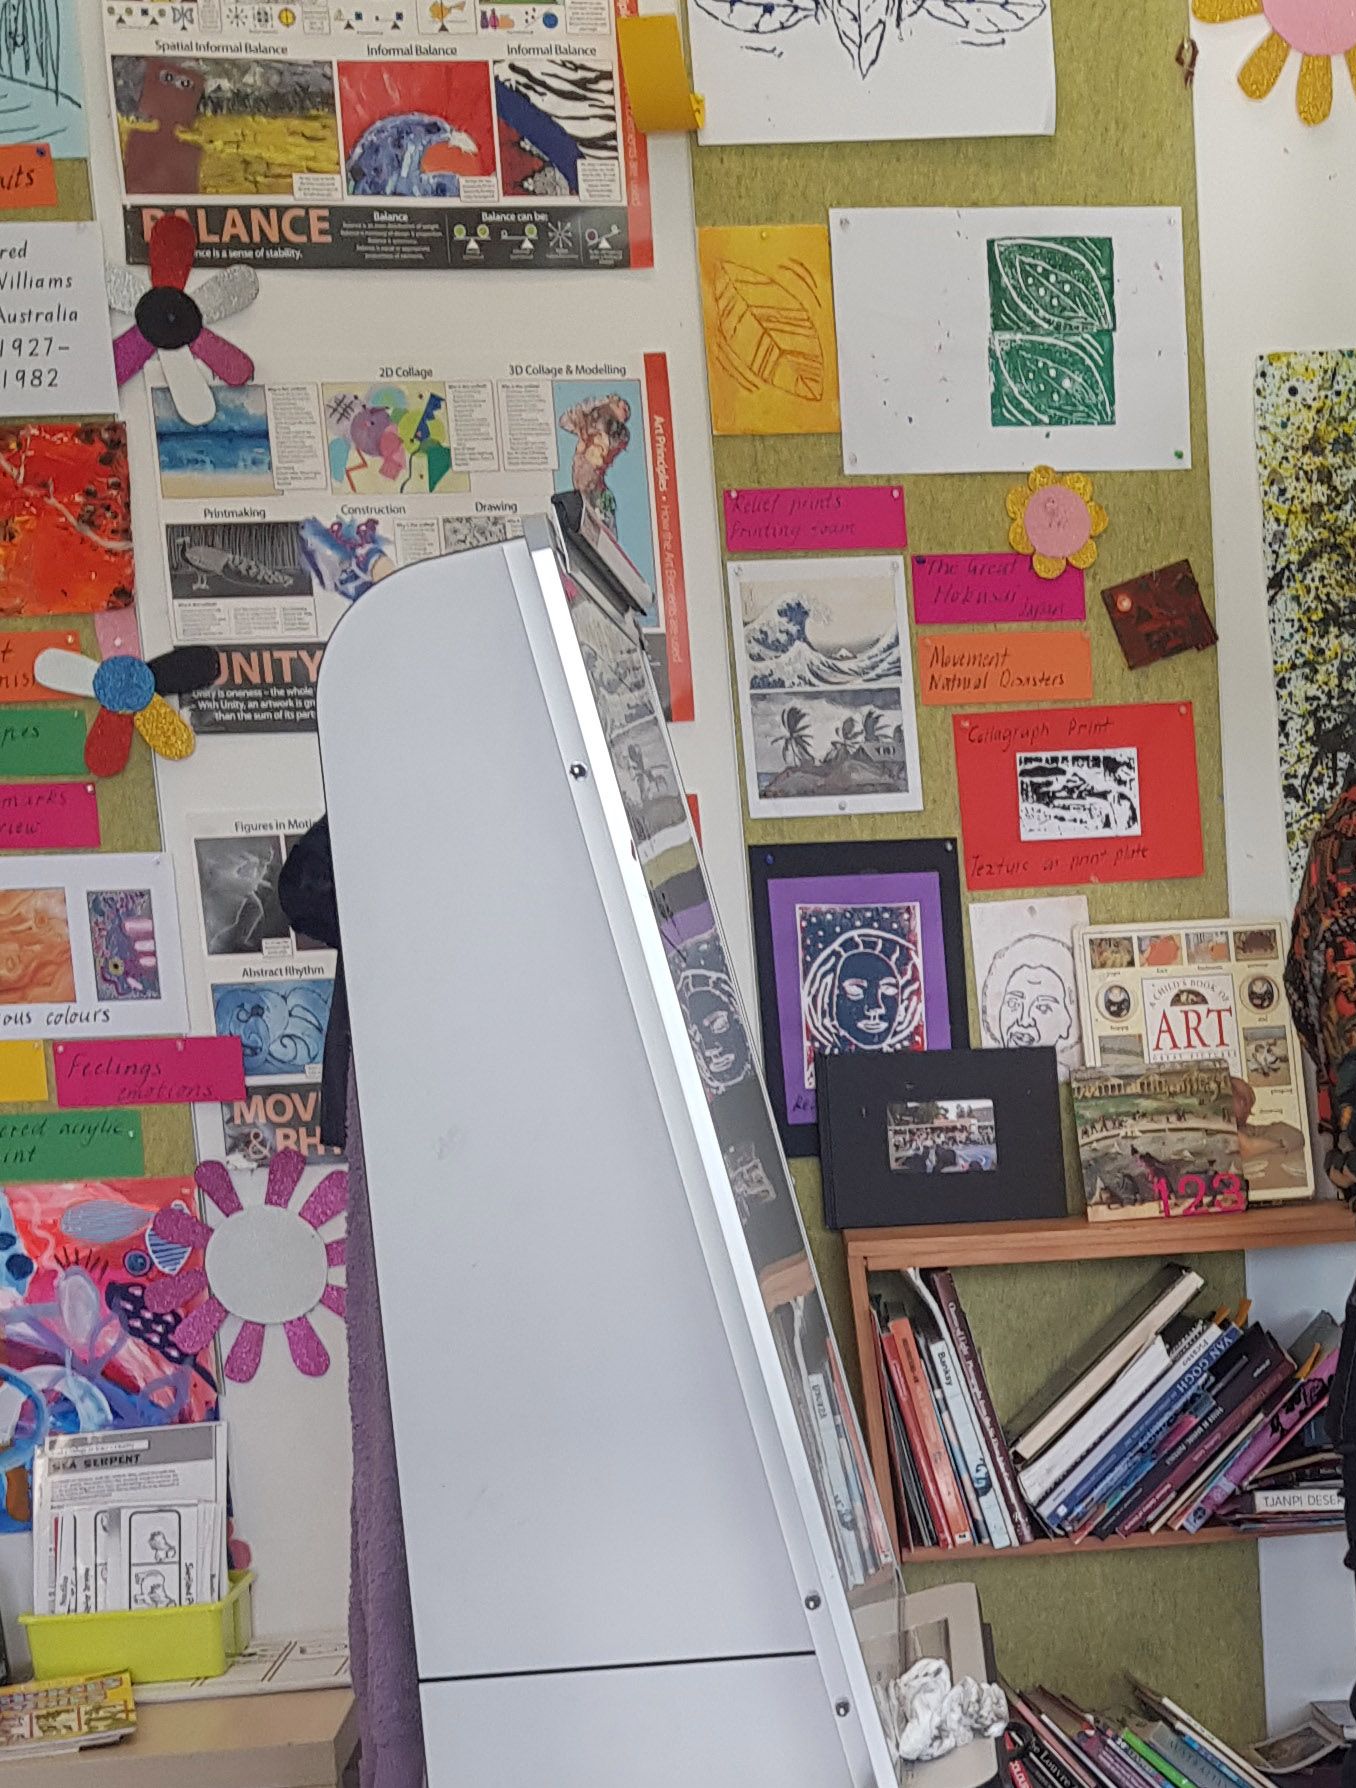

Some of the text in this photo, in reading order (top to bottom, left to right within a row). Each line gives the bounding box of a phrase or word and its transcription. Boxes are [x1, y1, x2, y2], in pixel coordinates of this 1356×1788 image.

[154, 39, 288, 55] Spatial Informal Balance
[366, 44, 458, 57] Informal Balance
[506, 43, 597, 57] Informal Balance
[373, 210, 409, 222] Balance
[481, 211, 515, 222] Balance
[516, 213, 533, 222] can
[140, 207, 333, 244] BLANCE
[2, 367, 59, 389] 1982
[379, 366, 433, 379] 2D Collage
[508, 363, 627, 377] 3D Collage & Modelling
[203, 506, 267, 520] Printmaking
[340, 503, 407, 515] Construction
[475, 501, 518, 514] Drawing
[929, 644, 1010, 669] Movement
[928, 670, 989, 693] Natural
[286, 686, 314, 697] whole
[1068, 716, 1113, 737] Print
[234, 820, 274, 833] Figures
[275, 820, 286, 830] in
[242, 965, 325, 979] Abstract Rhythm
[46, 1005, 111, 1025] colours
[1152, 1004, 1233, 1052] ART
[233, 1091, 322, 1125] MOV
[249, 1128, 271, 1159] &
[1207, 1334, 1234, 1362] VAN
[937, 1351, 954, 1387] Banksy
[1176, 1360, 1210, 1394] GOGH
[51, 1453, 142, 1471] SEA SERPENT
[1263, 1494, 1303, 1508] TJANPI
